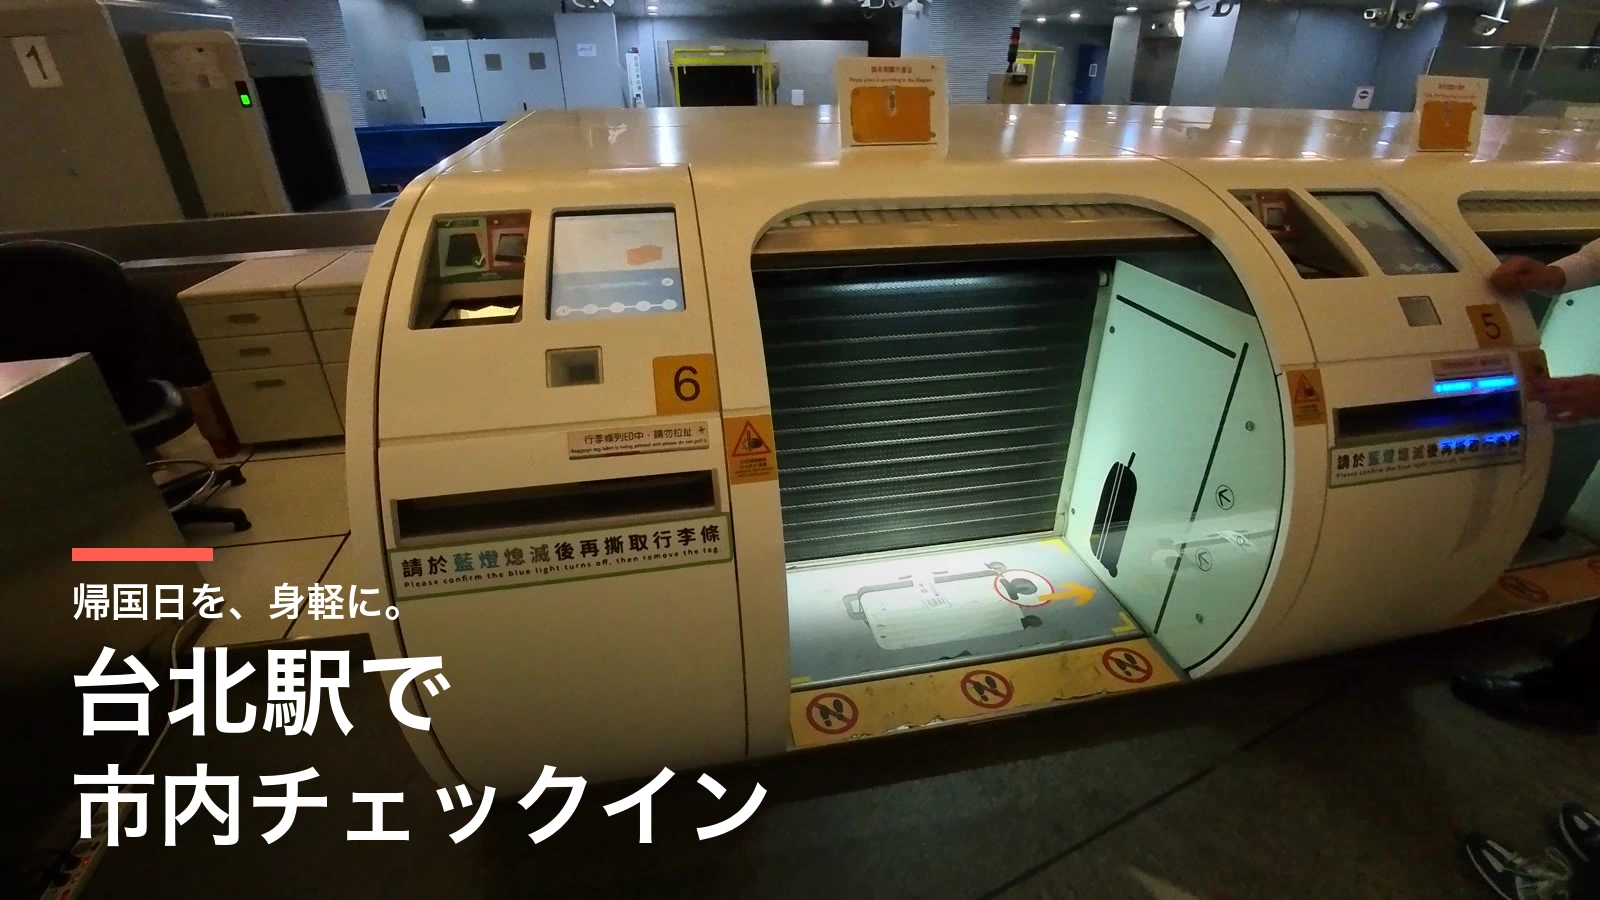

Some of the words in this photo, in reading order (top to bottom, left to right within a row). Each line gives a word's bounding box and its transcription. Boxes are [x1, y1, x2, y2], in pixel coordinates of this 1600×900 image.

[27, 45, 48, 80] 1
[1480, 312, 1501, 340] 5
[673, 365, 701, 402] 6
[401, 524, 721, 579] 請於藍燈熄滅後再撕取行李條
[404, 579, 439, 588] Please
[443, 574, 483, 584] confirm
[487, 571, 504, 579] the
[508, 568, 531, 577] blue
[535, 565, 559, 574] light
[564, 562, 591, 571] turns
[616, 556, 639, 564] then
[643, 551, 679, 561] remove
[683, 547, 699, 556] the
